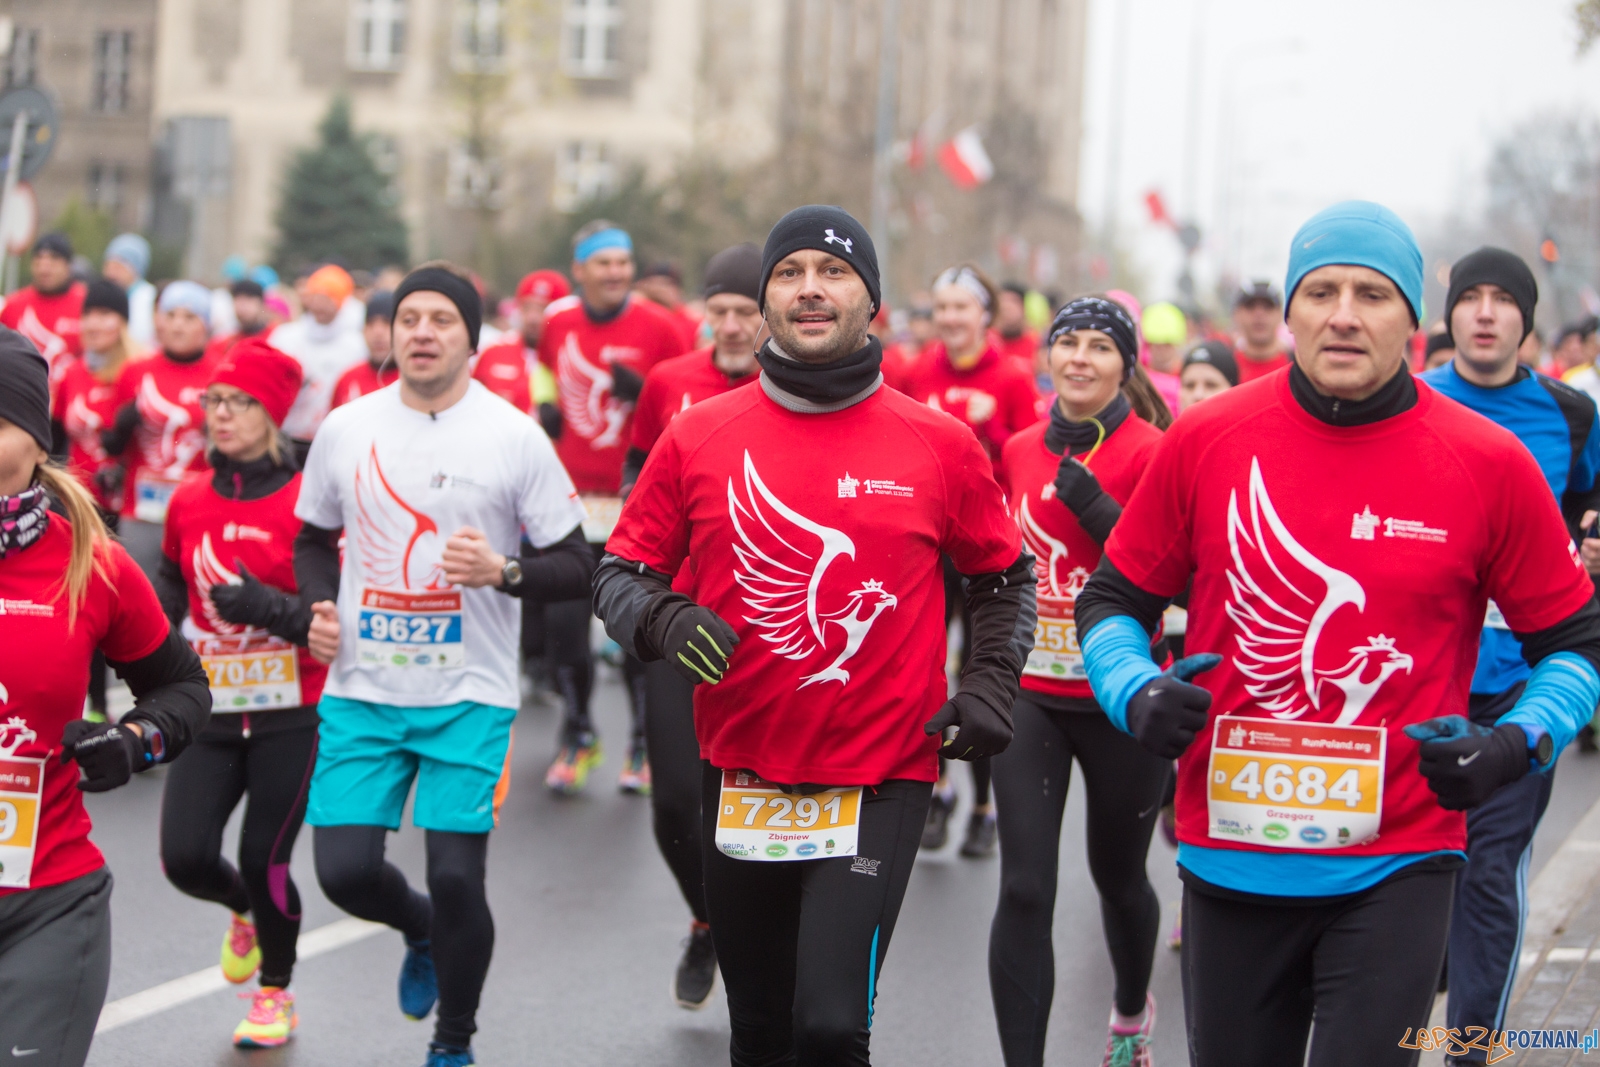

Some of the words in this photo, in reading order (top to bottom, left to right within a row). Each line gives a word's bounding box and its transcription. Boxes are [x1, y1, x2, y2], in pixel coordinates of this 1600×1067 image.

[369, 613, 452, 643] 9627
[209, 658, 286, 685] 7042
[1301, 737, 1372, 753] RunPoland.org
[1214, 770, 1227, 784] D
[1230, 761, 1363, 808] 4684
[723, 804, 735, 815] D
[740, 795, 843, 828] 7291
[1266, 809, 1315, 822] Grzegorz
[768, 833, 810, 842] Zbigniew
